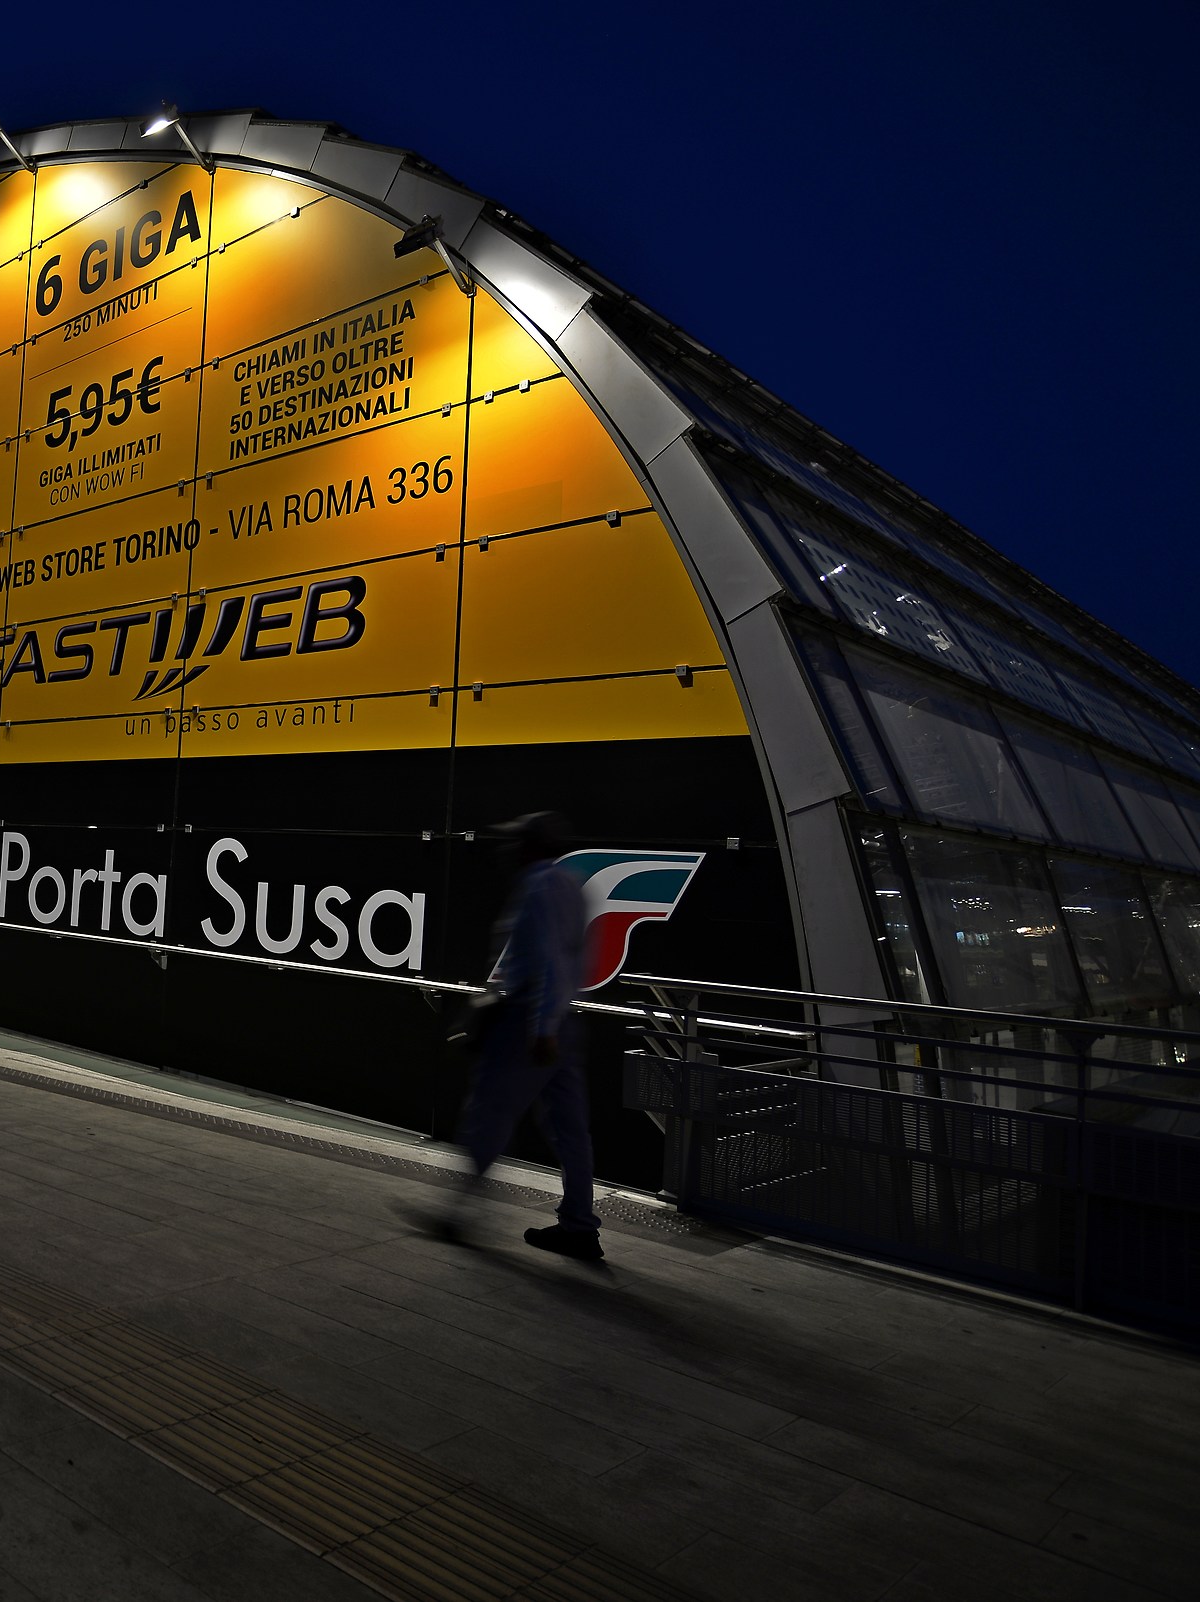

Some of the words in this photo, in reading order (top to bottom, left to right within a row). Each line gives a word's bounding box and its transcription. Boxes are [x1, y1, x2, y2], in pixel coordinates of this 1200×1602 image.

[36, 255, 63, 316] 6
[79, 191, 201, 295] GIGA
[63, 314, 92, 342] 250
[97, 282, 158, 327] MINUTI
[234, 338, 306, 382] CHIAMI
[313, 328, 335, 354] IN
[342, 299, 416, 344] ITALIA
[45, 356, 164, 452] 5,95€
[230, 411, 253, 435] 50
[259, 357, 414, 426] DESTINAZIONI
[240, 385, 251, 406] E
[257, 359, 325, 400] VERSO
[332, 331, 404, 374] OLTRE
[39, 463, 73, 487] GIGA
[78, 433, 161, 475] ILLIMITATI
[229, 387, 410, 460] INTERNAZIONALI
[41, 541, 105, 582] STORE
[113, 519, 201, 566] TORINO
[229, 501, 273, 541] VIA
[284, 475, 375, 529] ROMA
[387, 456, 454, 505] 336
[50, 482, 80, 505] CON
[86, 467, 125, 496] WOW
[130, 462, 144, 482] FI
[125, 716, 150, 737] un
[165, 709, 240, 739] passo
[256, 699, 356, 729] avanti
[200, 837, 426, 970] Susa
